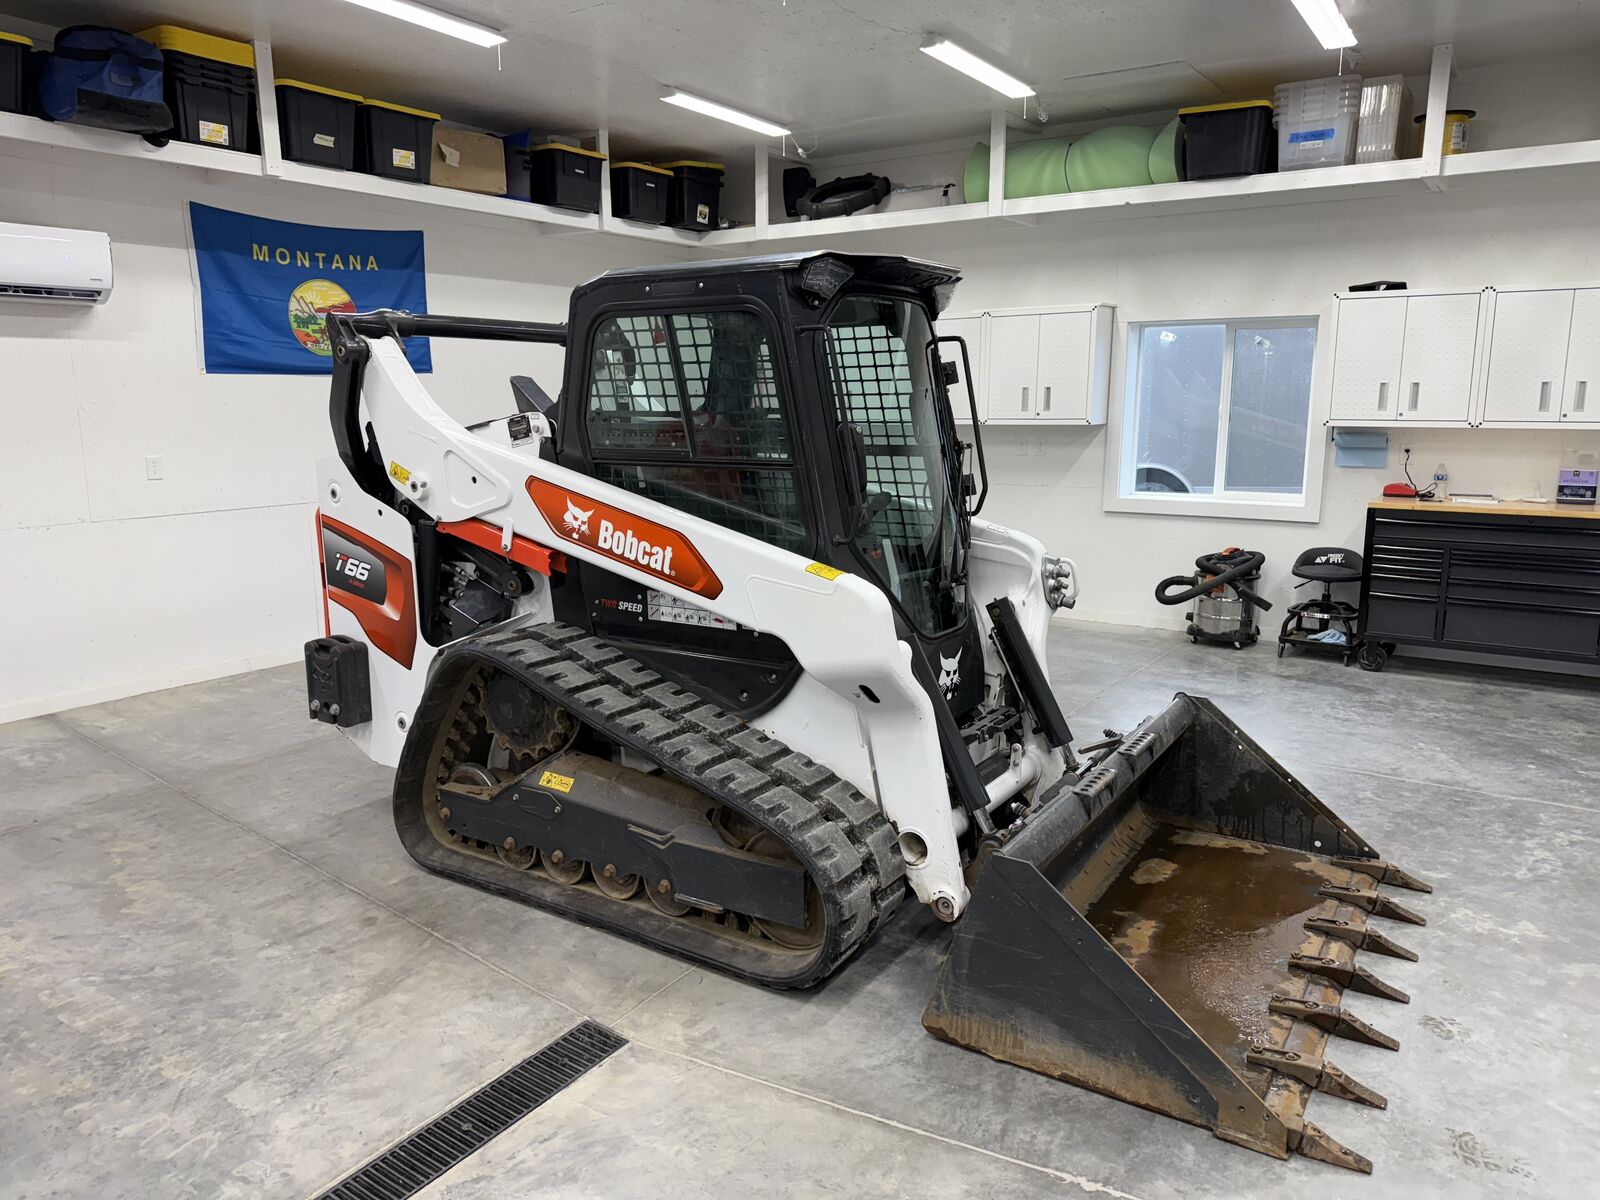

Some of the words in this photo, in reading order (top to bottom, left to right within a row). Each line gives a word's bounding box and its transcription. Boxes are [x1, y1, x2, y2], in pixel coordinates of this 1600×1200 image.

[252, 243, 379, 271] MONTANA
[598, 519, 673, 575] Bobcat
[335, 552, 371, 581] T66
[600, 598, 617, 608] TWO
[618, 601, 643, 613] SPEED
